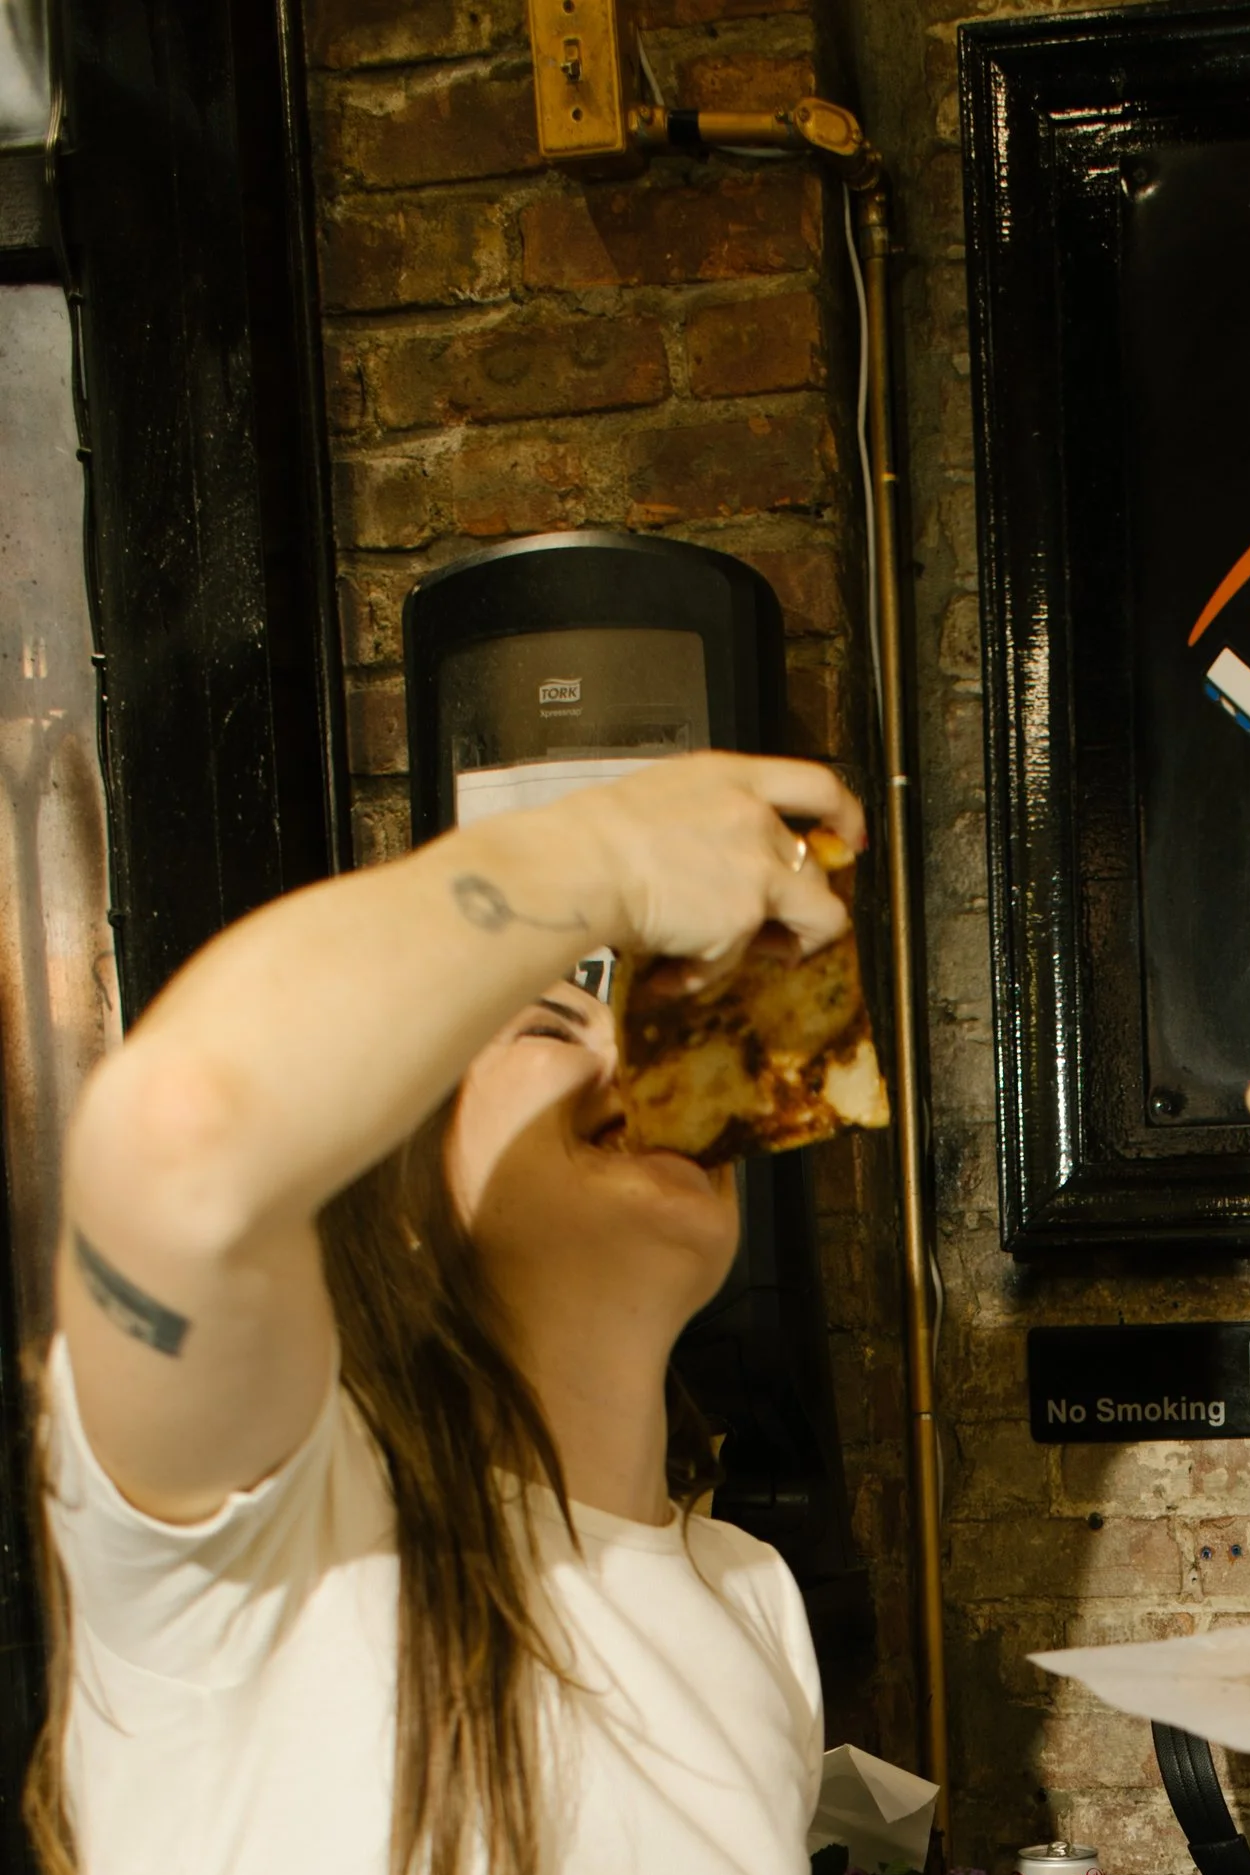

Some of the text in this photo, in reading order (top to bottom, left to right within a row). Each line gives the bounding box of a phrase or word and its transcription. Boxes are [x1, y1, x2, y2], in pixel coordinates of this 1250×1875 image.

[541, 685, 578, 701] TORK
[1047, 1397, 1226, 1427] No Smoking
